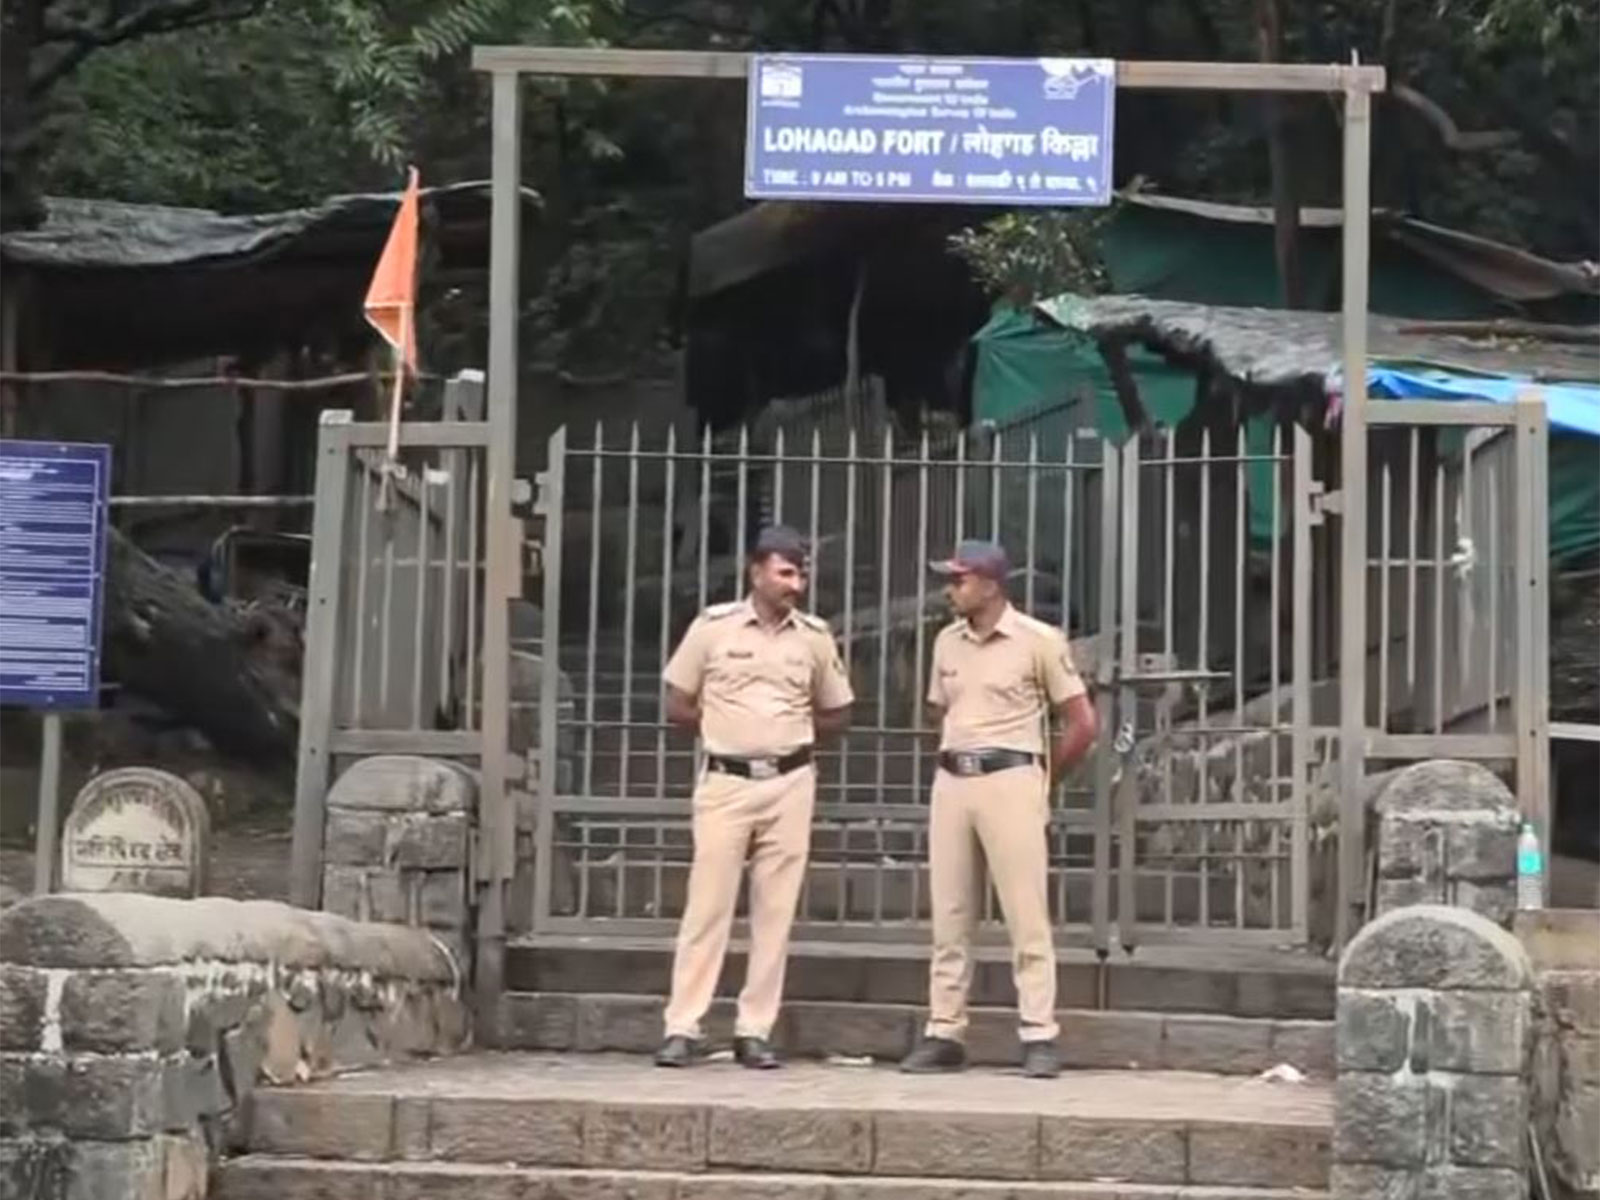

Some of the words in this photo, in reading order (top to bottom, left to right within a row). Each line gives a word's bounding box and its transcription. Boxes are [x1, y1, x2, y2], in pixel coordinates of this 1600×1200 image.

[764, 127, 877, 154] LOHAGAD
[883, 129, 945, 156] FORT
[851, 171, 873, 187] TO
